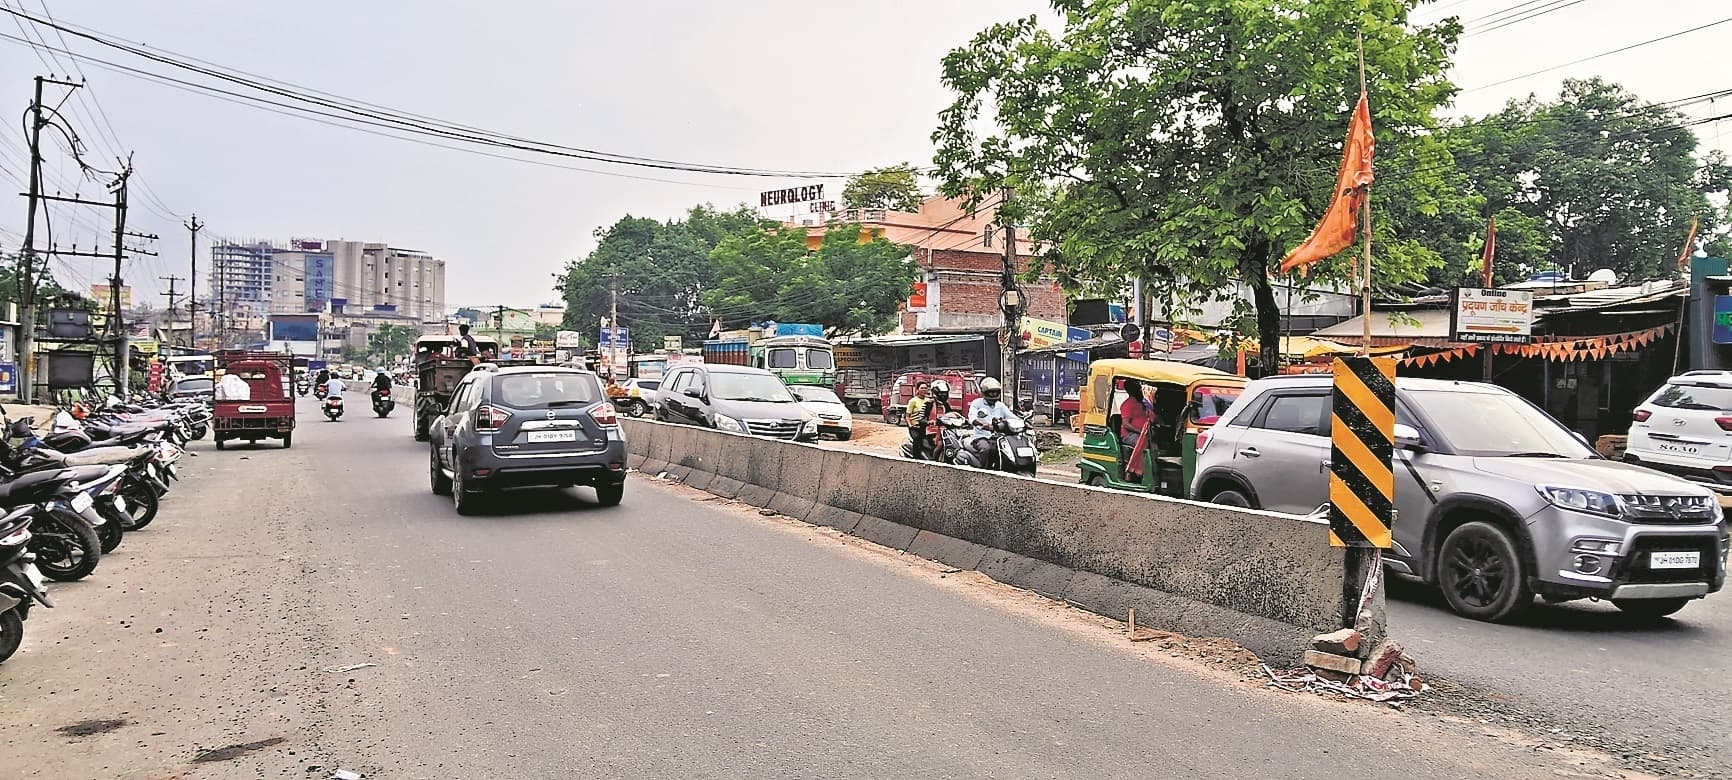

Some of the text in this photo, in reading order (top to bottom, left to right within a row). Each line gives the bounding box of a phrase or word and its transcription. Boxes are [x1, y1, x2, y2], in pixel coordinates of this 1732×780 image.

[760, 183, 824, 207] NEUROLOGY
[810, 200, 836, 213] CLINIC
[1481, 289, 1507, 298] Online
[1037, 326, 1063, 338] CAPTAIN
